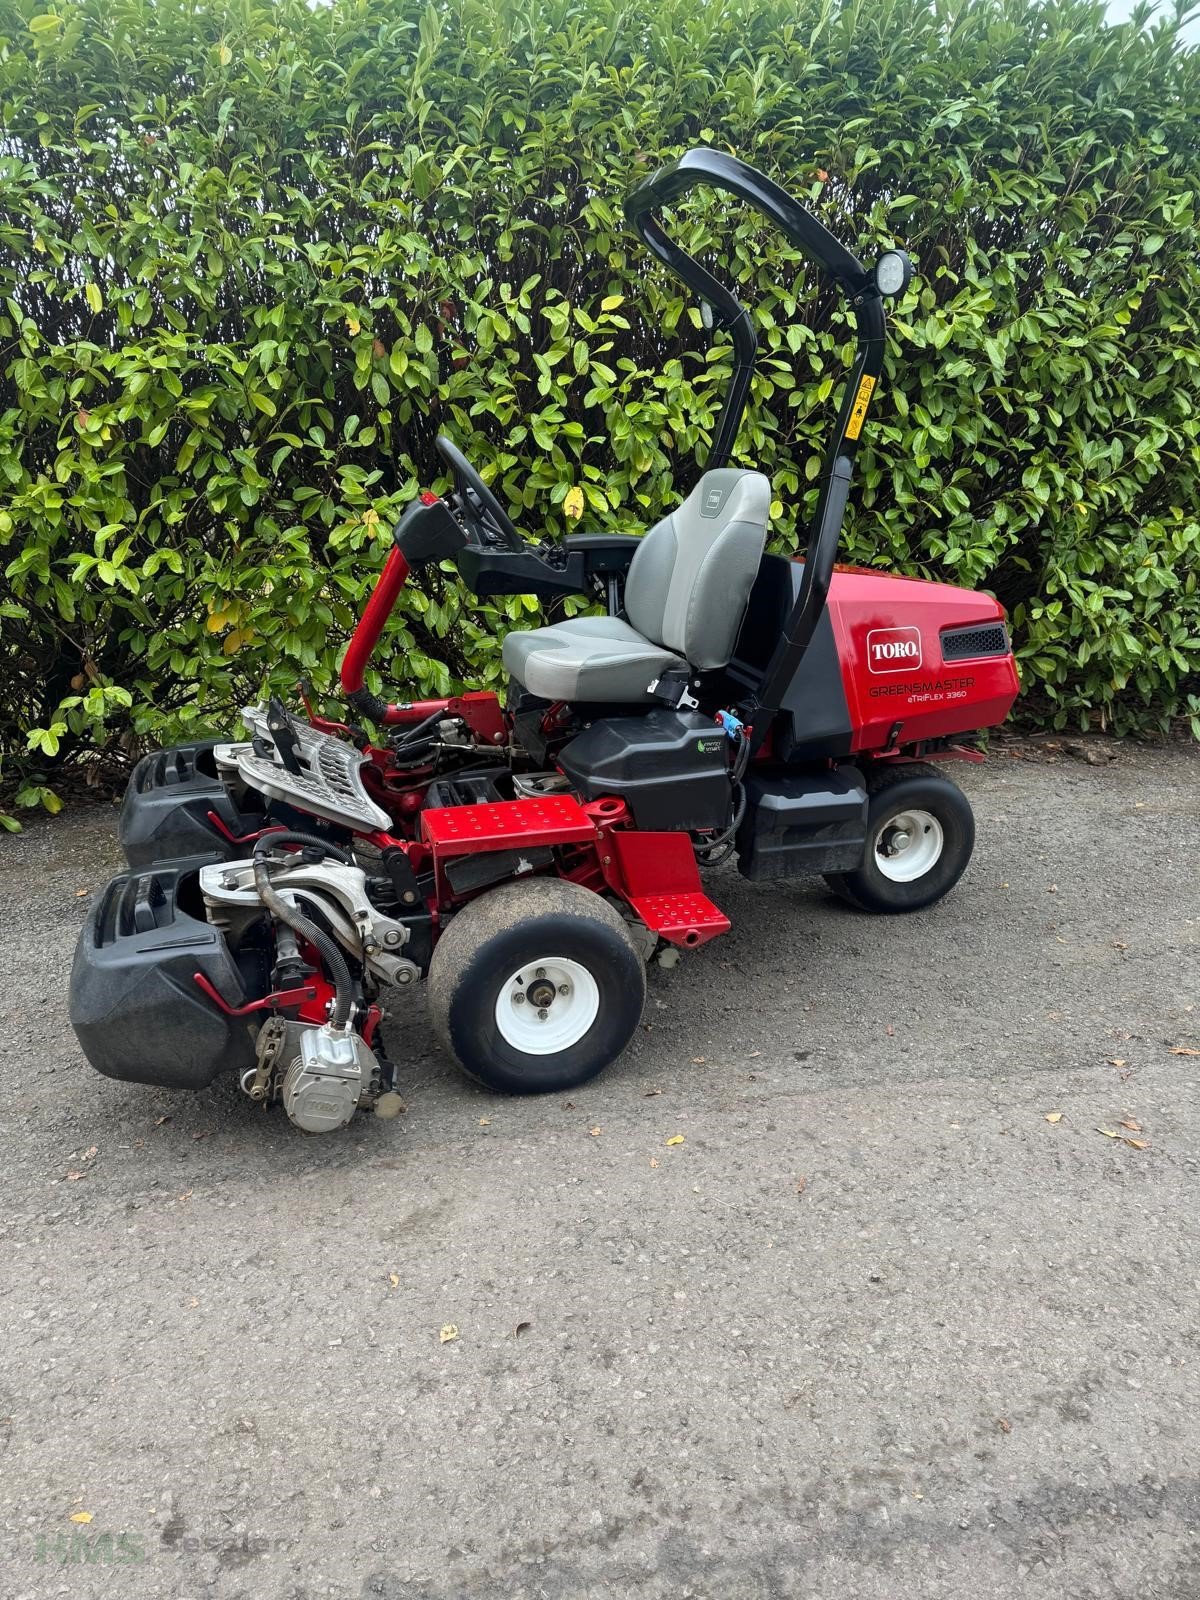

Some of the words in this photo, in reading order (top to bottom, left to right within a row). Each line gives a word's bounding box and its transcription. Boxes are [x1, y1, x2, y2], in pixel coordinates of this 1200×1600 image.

[872, 641, 915, 660] TORO
[869, 677, 975, 698] GREENSMASTER
[946, 690, 967, 699] 3360
